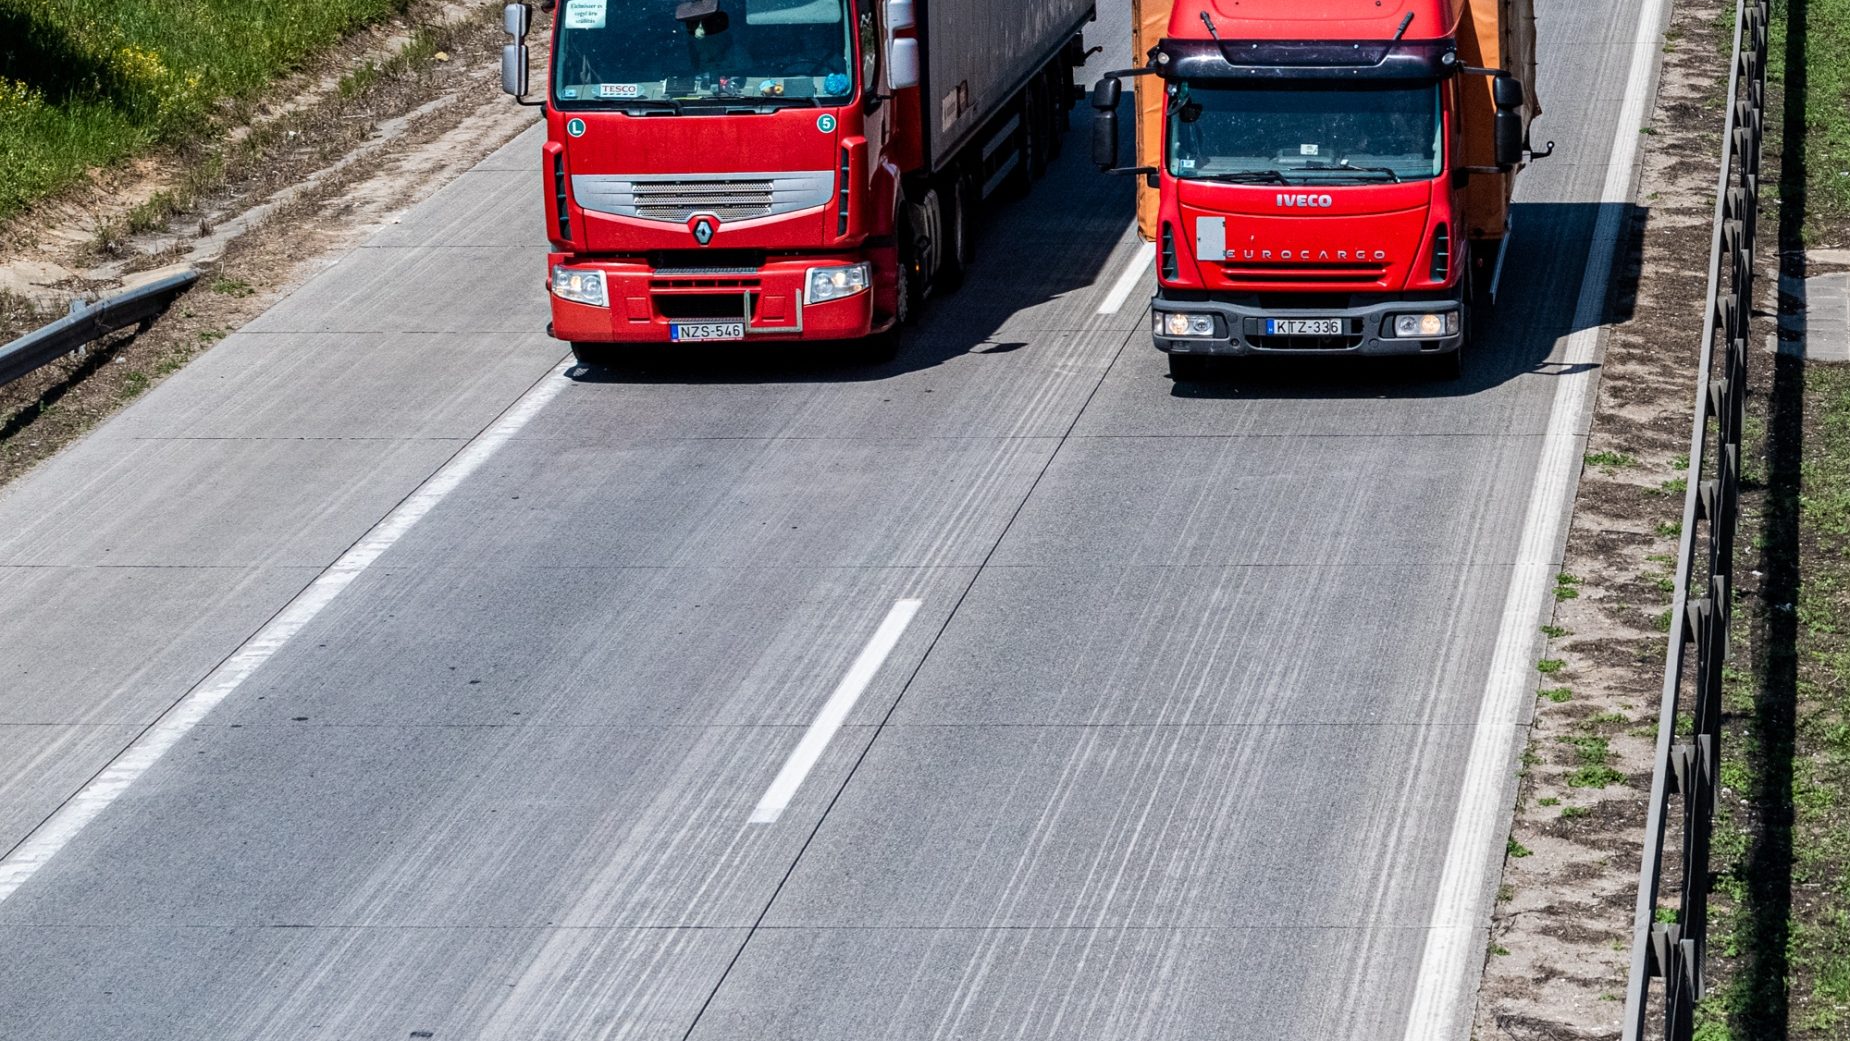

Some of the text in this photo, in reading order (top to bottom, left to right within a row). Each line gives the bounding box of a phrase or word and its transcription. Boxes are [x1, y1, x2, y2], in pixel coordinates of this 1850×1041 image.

[602, 85, 637, 93] TESCO
[572, 121, 582, 134] L
[822, 117, 831, 129] 5
[1276, 194, 1332, 207] IVECO
[1225, 249, 1386, 259] EUROCARGO
[681, 324, 741, 338] NZS-546
[1277, 318, 1339, 334] KTZ-336
